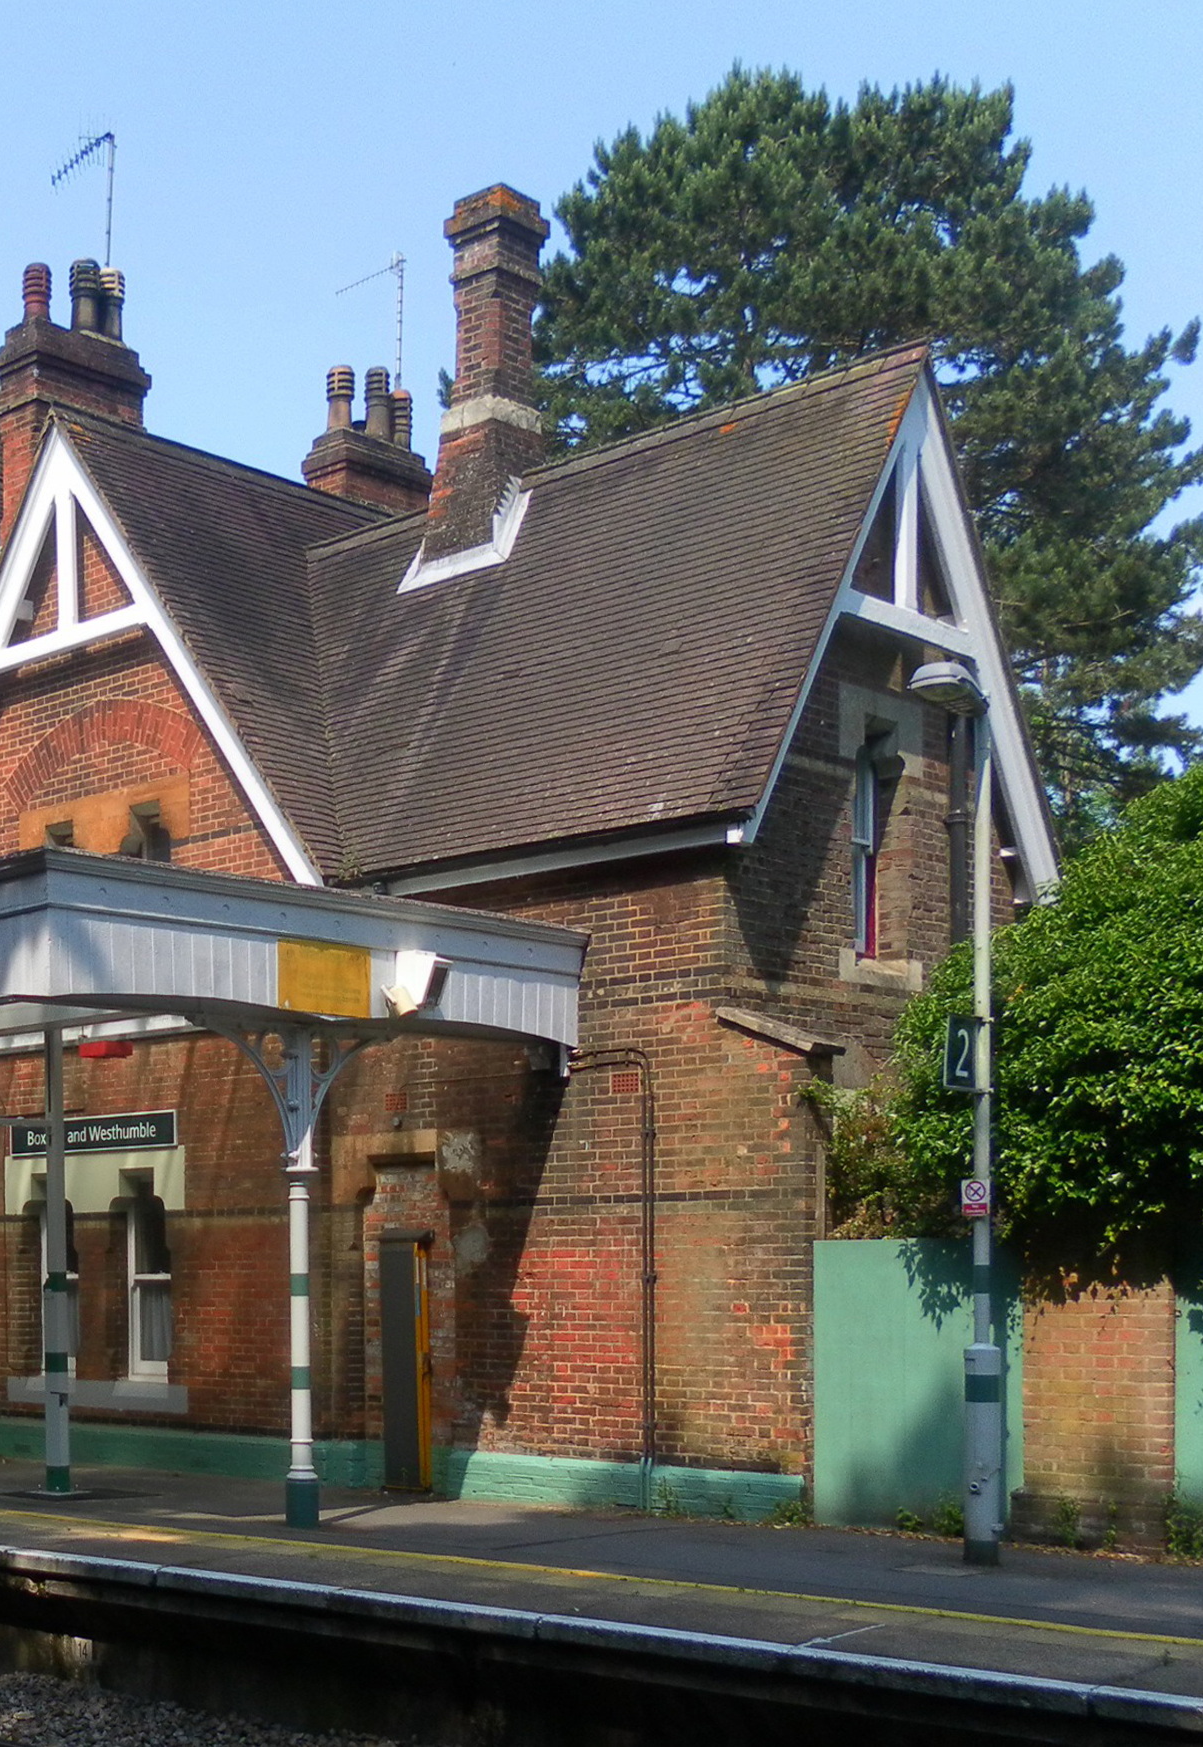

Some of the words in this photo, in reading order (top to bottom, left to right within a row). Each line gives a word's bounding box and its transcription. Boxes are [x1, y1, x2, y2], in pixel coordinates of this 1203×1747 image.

[955, 1028, 969, 1077] 2
[27, 1130, 47, 1146] Box
[67, 1126, 87, 1143] and
[88, 1121, 157, 1142] Westhumble
